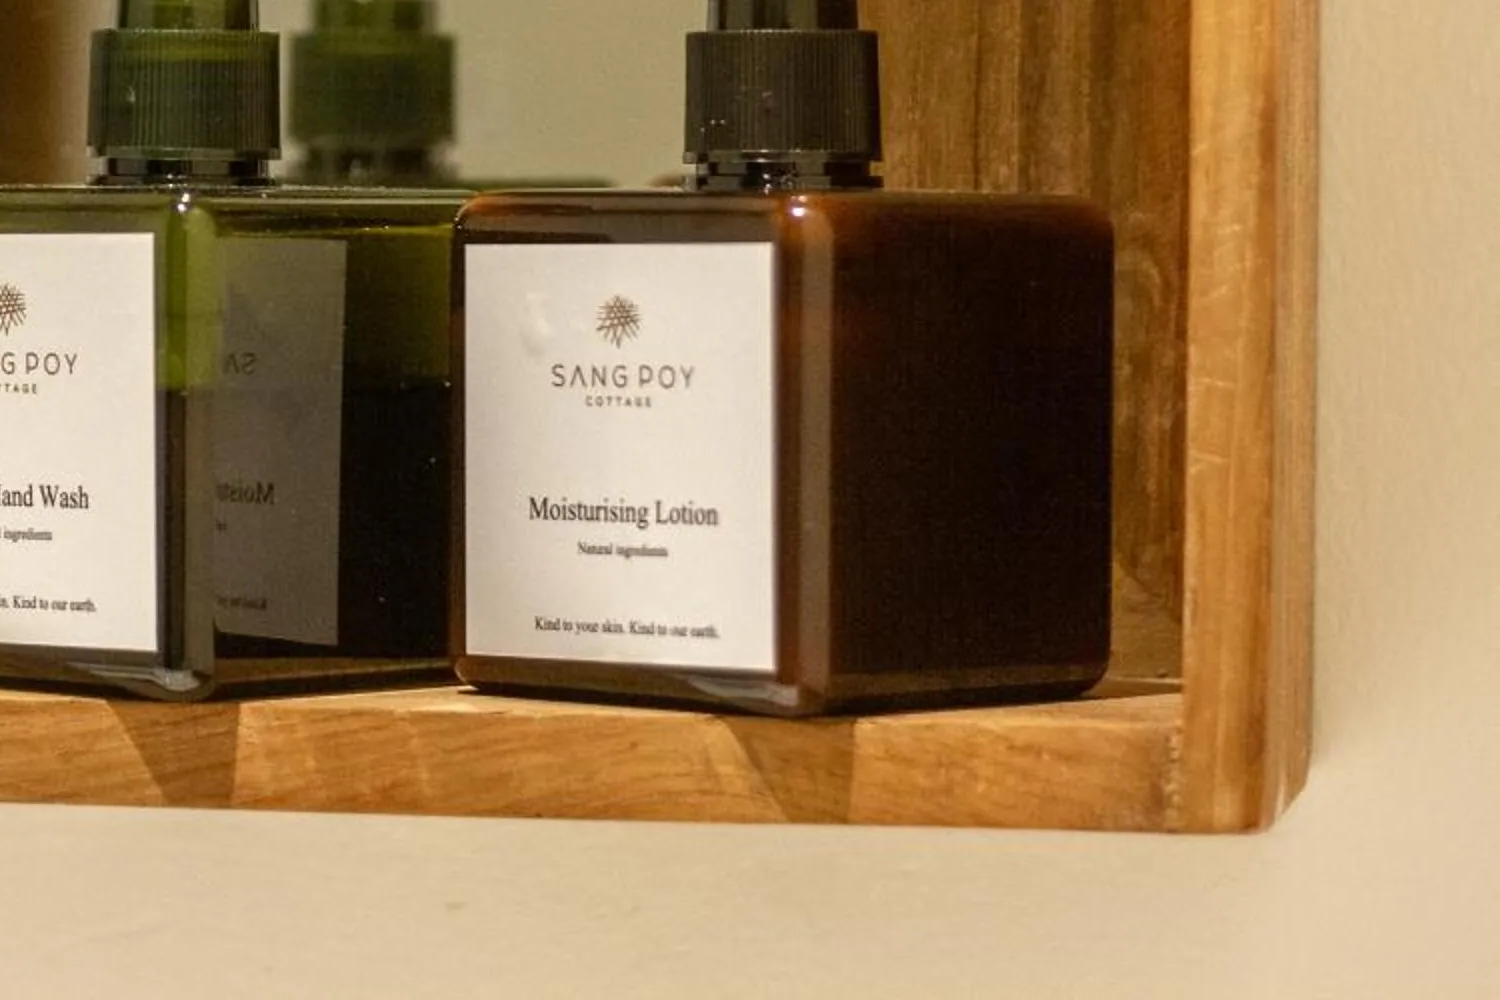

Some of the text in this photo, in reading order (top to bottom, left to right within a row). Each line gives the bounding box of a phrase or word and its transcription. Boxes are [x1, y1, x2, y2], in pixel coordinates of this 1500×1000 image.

[25, 352, 78, 375] POY
[551, 363, 695, 389] SANG POY
[585, 395, 652, 408] COTTAGE
[39, 485, 90, 509] Wash
[528, 496, 719, 529] Moisturising Lotion
[577, 541, 613, 555] Natural
[13, 595, 37, 609] Kind
[39, 598, 49, 611] to
[534, 616, 561, 631] Kind
[562, 618, 573, 631] to
[575, 620, 599, 635] your
[629, 620, 656, 635] Kind
[657, 622, 668, 636] to
